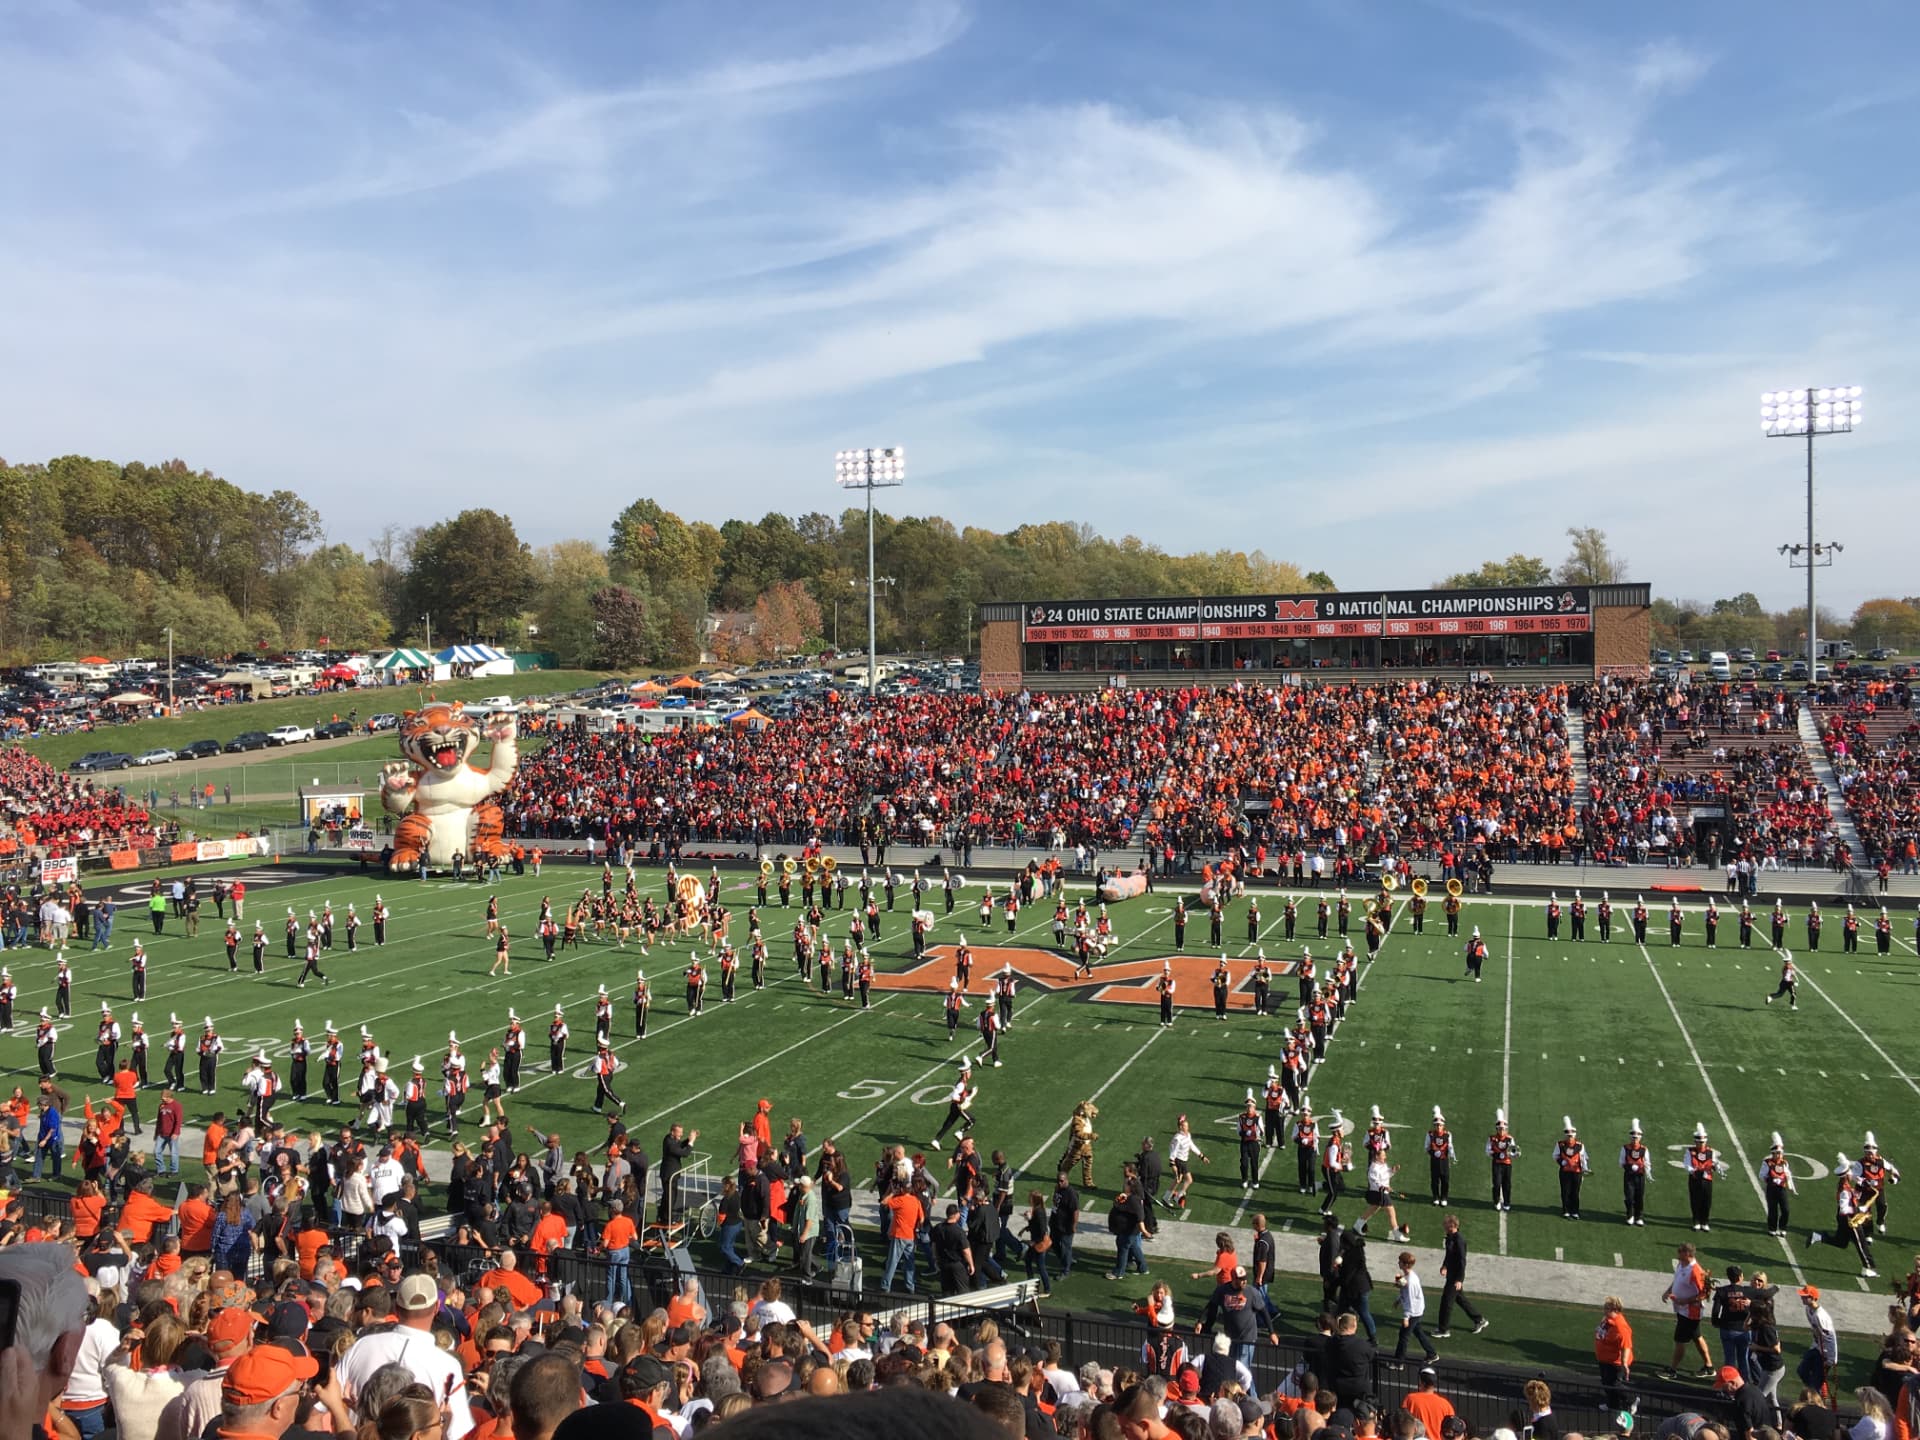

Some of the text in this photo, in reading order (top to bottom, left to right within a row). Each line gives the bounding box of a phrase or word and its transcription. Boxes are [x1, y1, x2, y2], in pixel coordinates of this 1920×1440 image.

[1047, 604, 1267, 622] 24 OHIO STATE CHAMPIONSHIPS
[1275, 599, 1319, 620] M
[1326, 596, 1554, 616] 9 NATIONAL CHAMPIONSHIPS
[1072, 629, 1088, 639] 1922
[1092, 628, 1109, 638] 1935
[1135, 628, 1152, 637] 1937
[1203, 626, 1221, 636] 1940
[1225, 626, 1242, 636] 1941
[1248, 625, 1265, 635] 1943
[1271, 625, 1288, 634] 1948
[1294, 624, 1312, 634] 1949
[1340, 623, 1357, 633] 1951
[1363, 623, 1381, 633] 1952
[1414, 622, 1434, 632] 1954
[1464, 620, 1484, 631] 1960
[1489, 620, 1508, 630] 1961
[1514, 619, 1534, 630] 1964
[1540, 619, 1560, 629] 1965
[1566, 618, 1586, 629] 1970
[350, 830, 373, 840] WHBC
[44, 859, 67, 870] 990
[860, 943, 1297, 1010] M
[836, 1079, 953, 1106] 50
